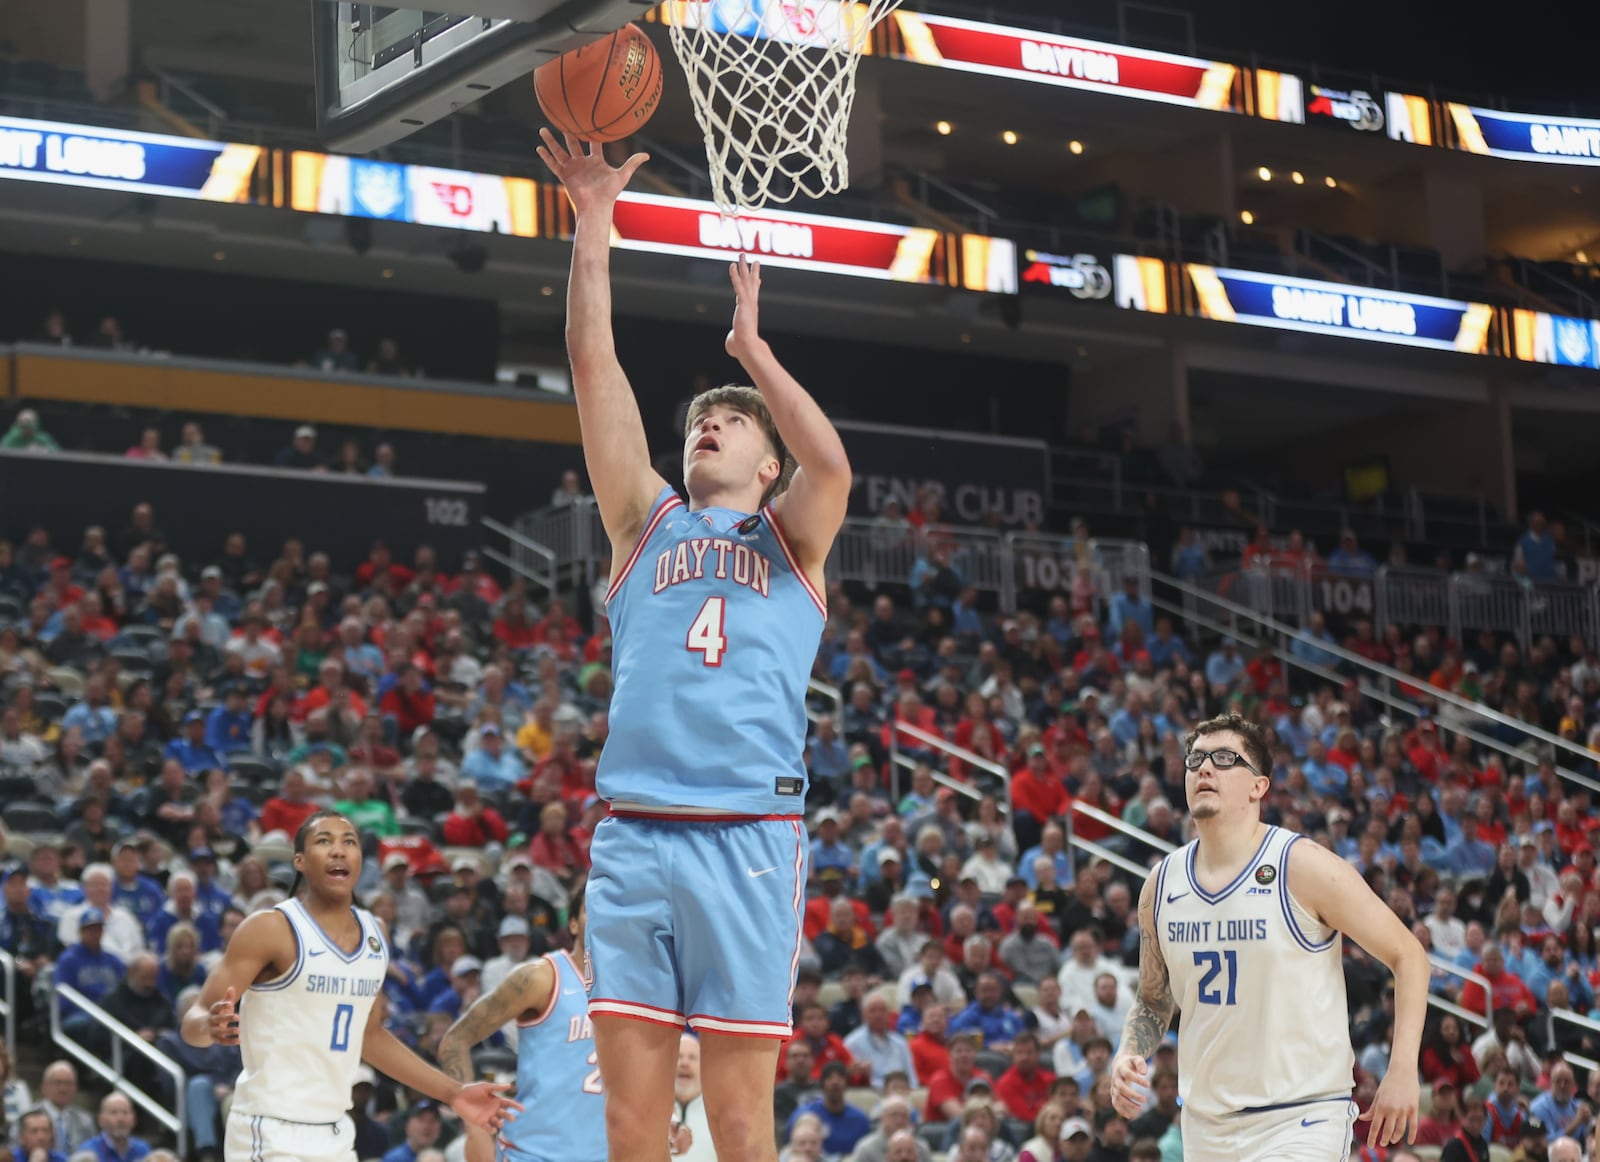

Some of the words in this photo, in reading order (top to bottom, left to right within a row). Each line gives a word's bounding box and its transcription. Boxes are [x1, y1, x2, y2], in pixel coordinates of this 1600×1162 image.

[1021, 40, 1119, 84] DAYTON
[0, 129, 42, 169] NT
[46, 134, 146, 180] LOUIS
[698, 213, 813, 258] DAYTON
[1272, 285, 1345, 326] SAINT
[1347, 295, 1417, 336] LOUIS
[424, 498, 468, 526] 102
[653, 538, 771, 599] DAYTON
[1023, 555, 1076, 591] 103
[1322, 580, 1373, 615] 104
[686, 596, 728, 668] 4
[1168, 921, 1211, 943] SAINT
[1217, 918, 1267, 942] LOUIS
[306, 974, 347, 996] SAINT
[350, 979, 381, 997] LOUIS
[1192, 950, 1238, 1006] 21
[330, 1003, 354, 1052] 0
